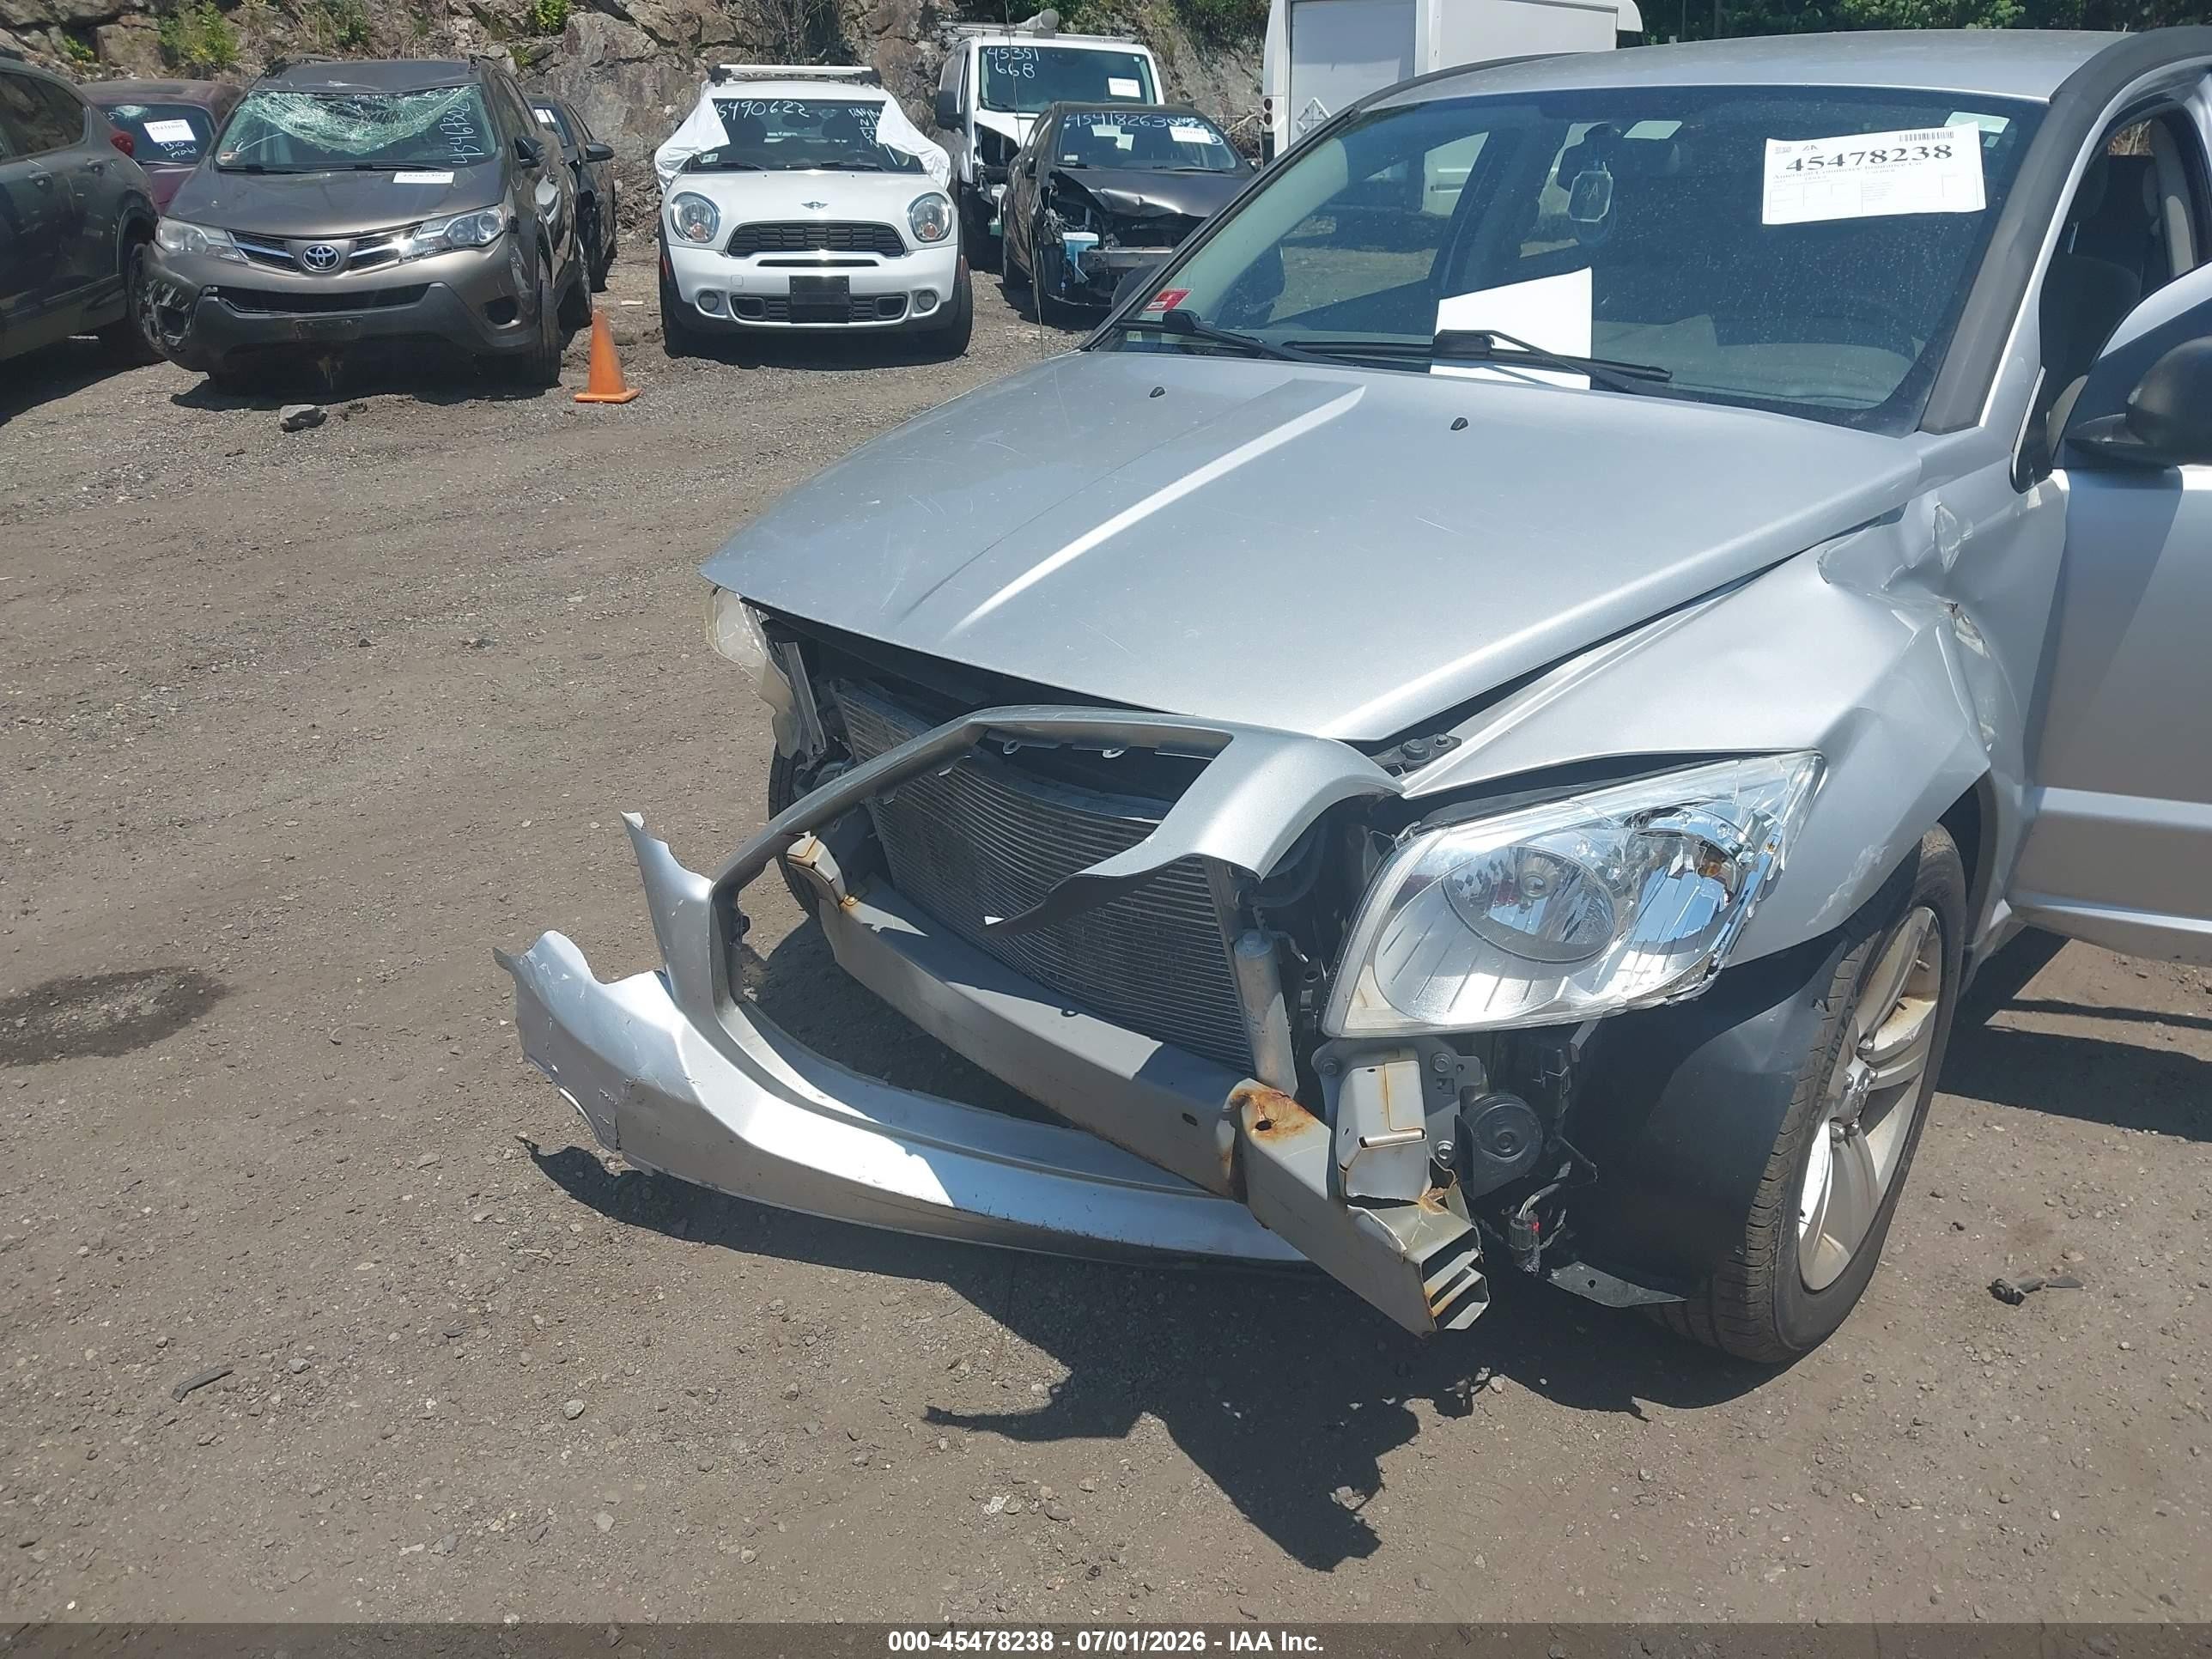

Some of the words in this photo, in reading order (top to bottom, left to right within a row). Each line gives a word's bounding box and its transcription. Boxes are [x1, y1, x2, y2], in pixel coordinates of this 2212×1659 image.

[987, 47, 1039, 62] 45351
[995, 62, 1036, 78] 668
[439, 101, 485, 164] 45467302
[1785, 144, 1953, 172] 45478238
